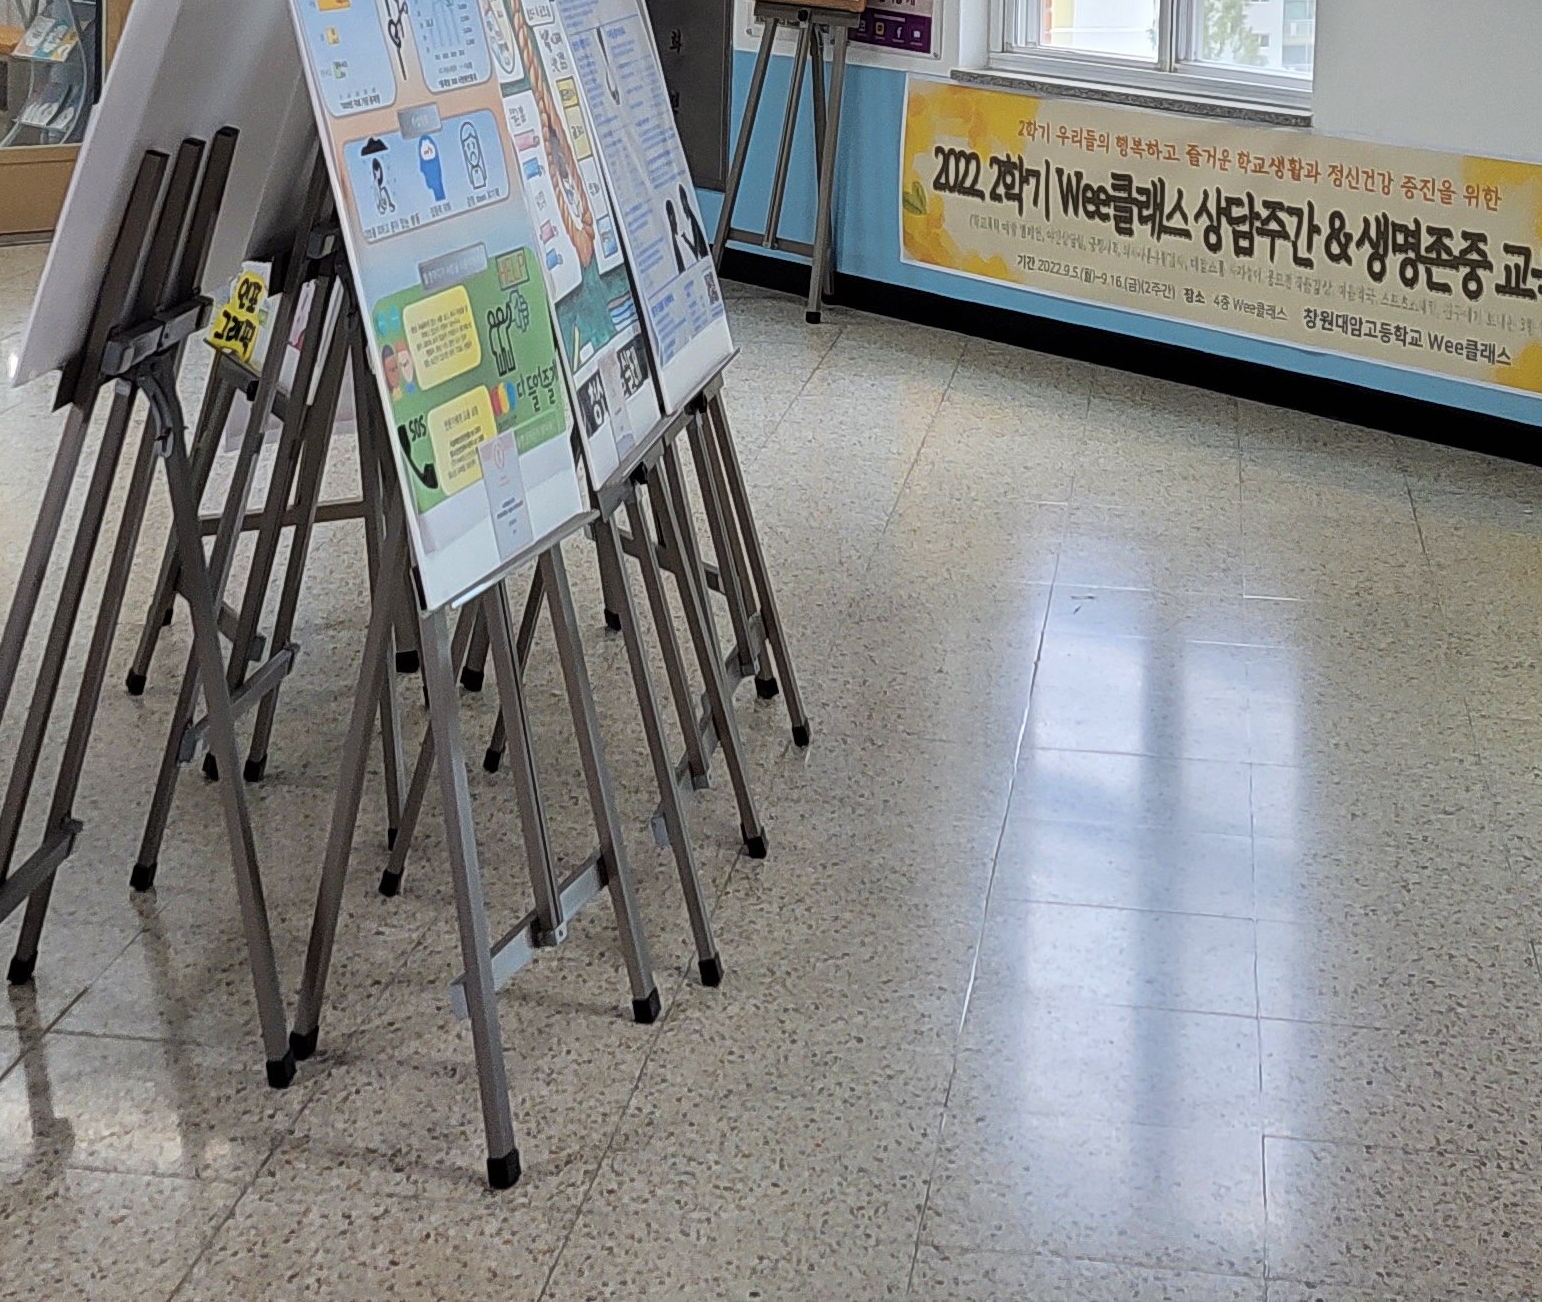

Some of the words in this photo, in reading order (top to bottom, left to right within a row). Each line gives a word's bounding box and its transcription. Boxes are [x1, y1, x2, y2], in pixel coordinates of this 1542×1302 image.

[1017, 118, 1051, 145] 2학기
[1055, 125, 1111, 154] 우리들의
[1114, 134, 1181, 163] 행복하고
[1185, 142, 1233, 172] 즐거운
[1236, 149, 1321, 185] 학교생활과
[1327, 163, 1394, 197] 정신건강
[1399, 175, 1457, 205] 증진을
[1462, 183, 1503, 213] 위한
[1016, 253, 1036, 271] 기간
[1182, 286, 1206, 305] 장소
[1232, 298, 1290, 322] Wee클래스
[1302, 307, 1425, 351] 창원대암고등학교
[1426, 333, 1513, 367] Wee클래스
[408, 414, 427, 443] SOS
